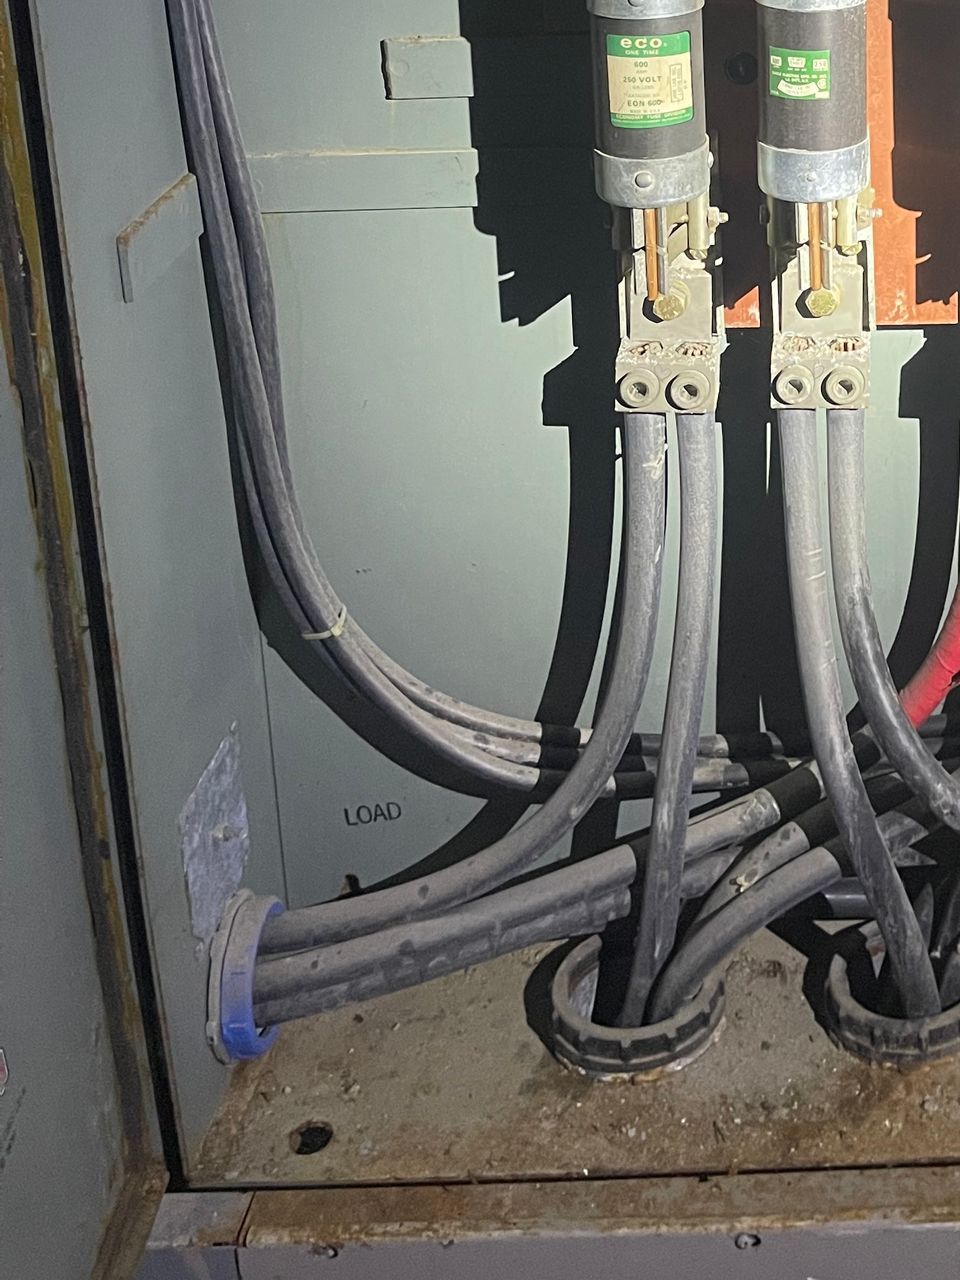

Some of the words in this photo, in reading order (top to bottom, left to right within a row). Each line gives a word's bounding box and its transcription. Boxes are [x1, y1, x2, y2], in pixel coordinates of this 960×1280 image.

[623, 76, 637, 84] 250
[638, 75, 663, 83] VOLT
[344, 802, 402, 826] LOAD
